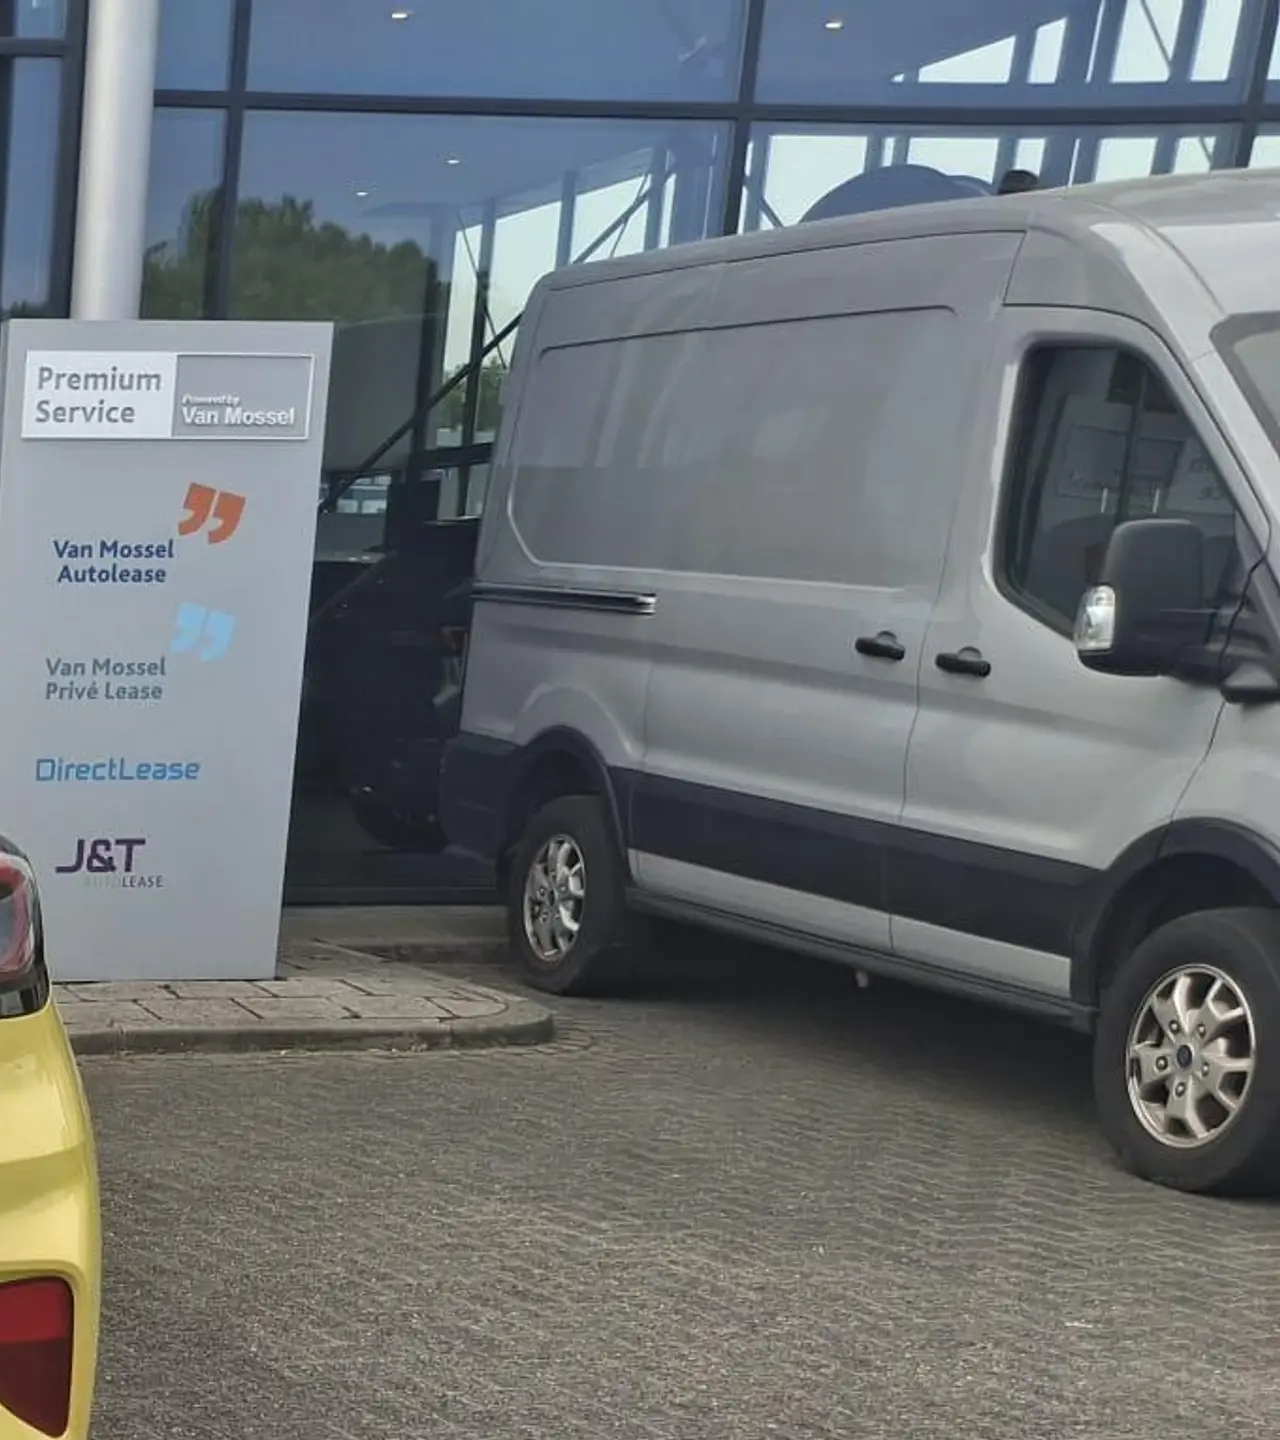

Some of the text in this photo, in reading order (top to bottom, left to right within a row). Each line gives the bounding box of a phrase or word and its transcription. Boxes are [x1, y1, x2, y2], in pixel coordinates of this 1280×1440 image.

[38, 366, 161, 391] Premium
[36, 399, 134, 423] Service
[183, 404, 294, 427] Van Mossel
[53, 539, 173, 558] Van Mossel
[57, 563, 166, 583] Autolease
[46, 656, 166, 676] Van Mossel
[46, 681, 162, 700] Privé Lease
[36, 758, 200, 782] DirectLease
[55, 838, 146, 873] J&T
